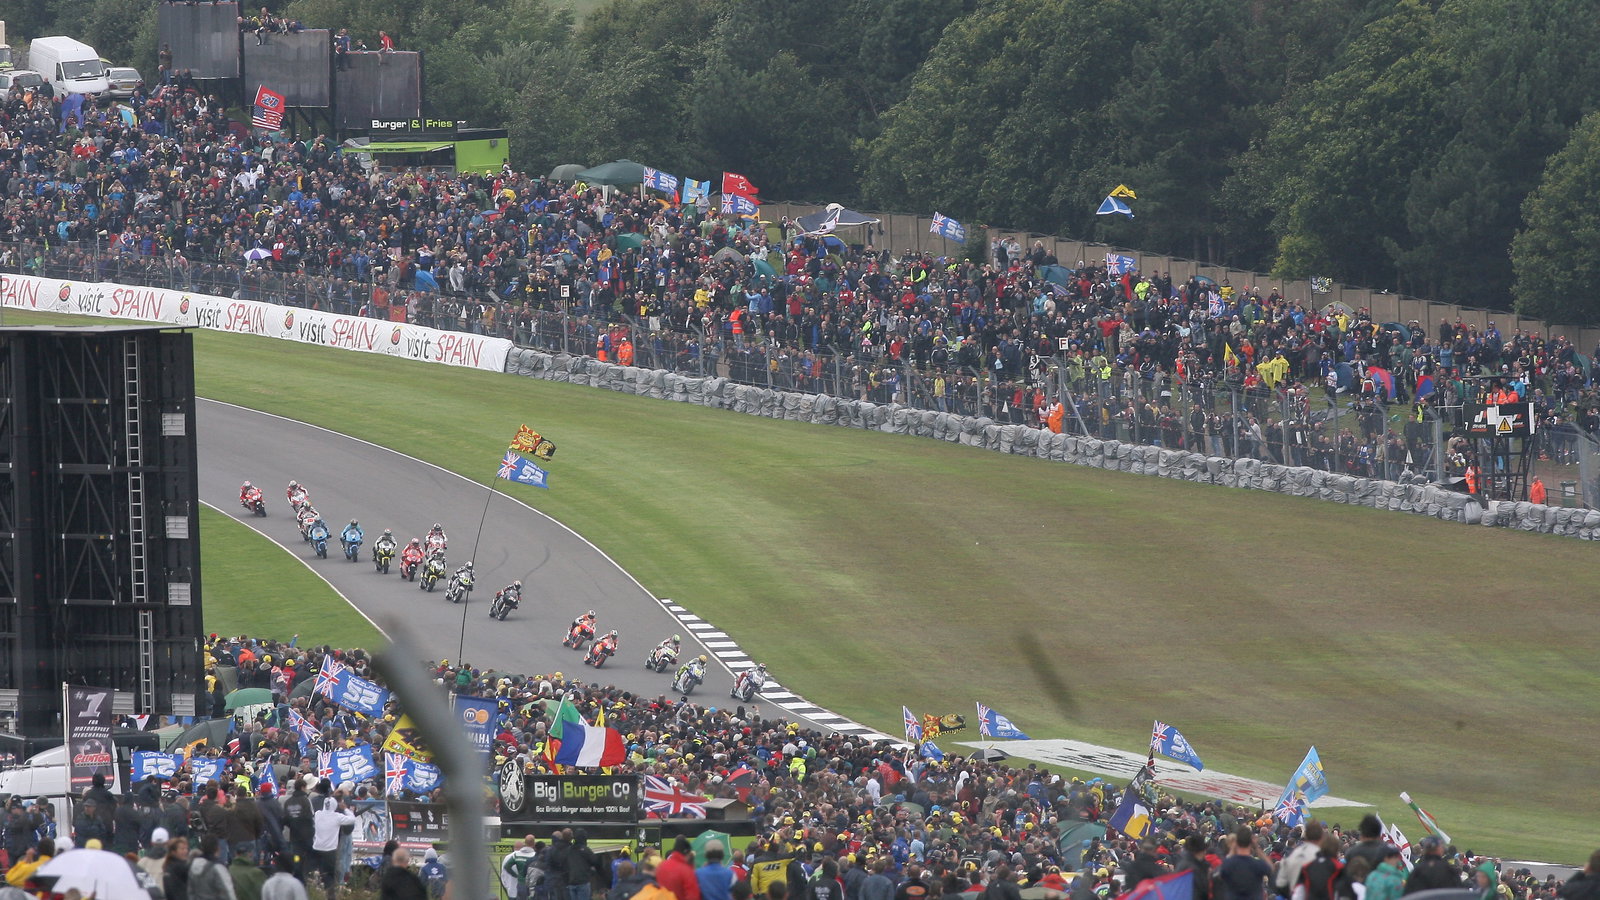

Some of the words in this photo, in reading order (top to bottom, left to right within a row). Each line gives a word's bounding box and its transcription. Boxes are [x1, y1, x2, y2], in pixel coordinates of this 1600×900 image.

[372, 119, 407, 131] Burger
[412, 119, 420, 128] &
[426, 119, 453, 128] Fries
[562, 286, 568, 296] F
[79, 287, 104, 314] visit
[110, 288, 165, 320] SPAIN
[195, 301, 221, 328] visit
[225, 303, 268, 334] SPAIN
[300, 316, 326, 344] visit
[330, 319, 378, 350] SPAIN
[1060, 338, 1067, 348] F
[407, 332, 431, 359] visit
[435, 334, 485, 367] SPAIN
[518, 465, 544, 484] 52
[74, 691, 108, 718] #1
[343, 680, 380, 711] 52
[140, 758, 176, 780] 52
[337, 755, 374, 780] 52
[534, 782, 558, 802] Big
[563, 782, 611, 802] Burger
[562, 805, 579, 814] Burger
[763, 863, 781, 871] 46
